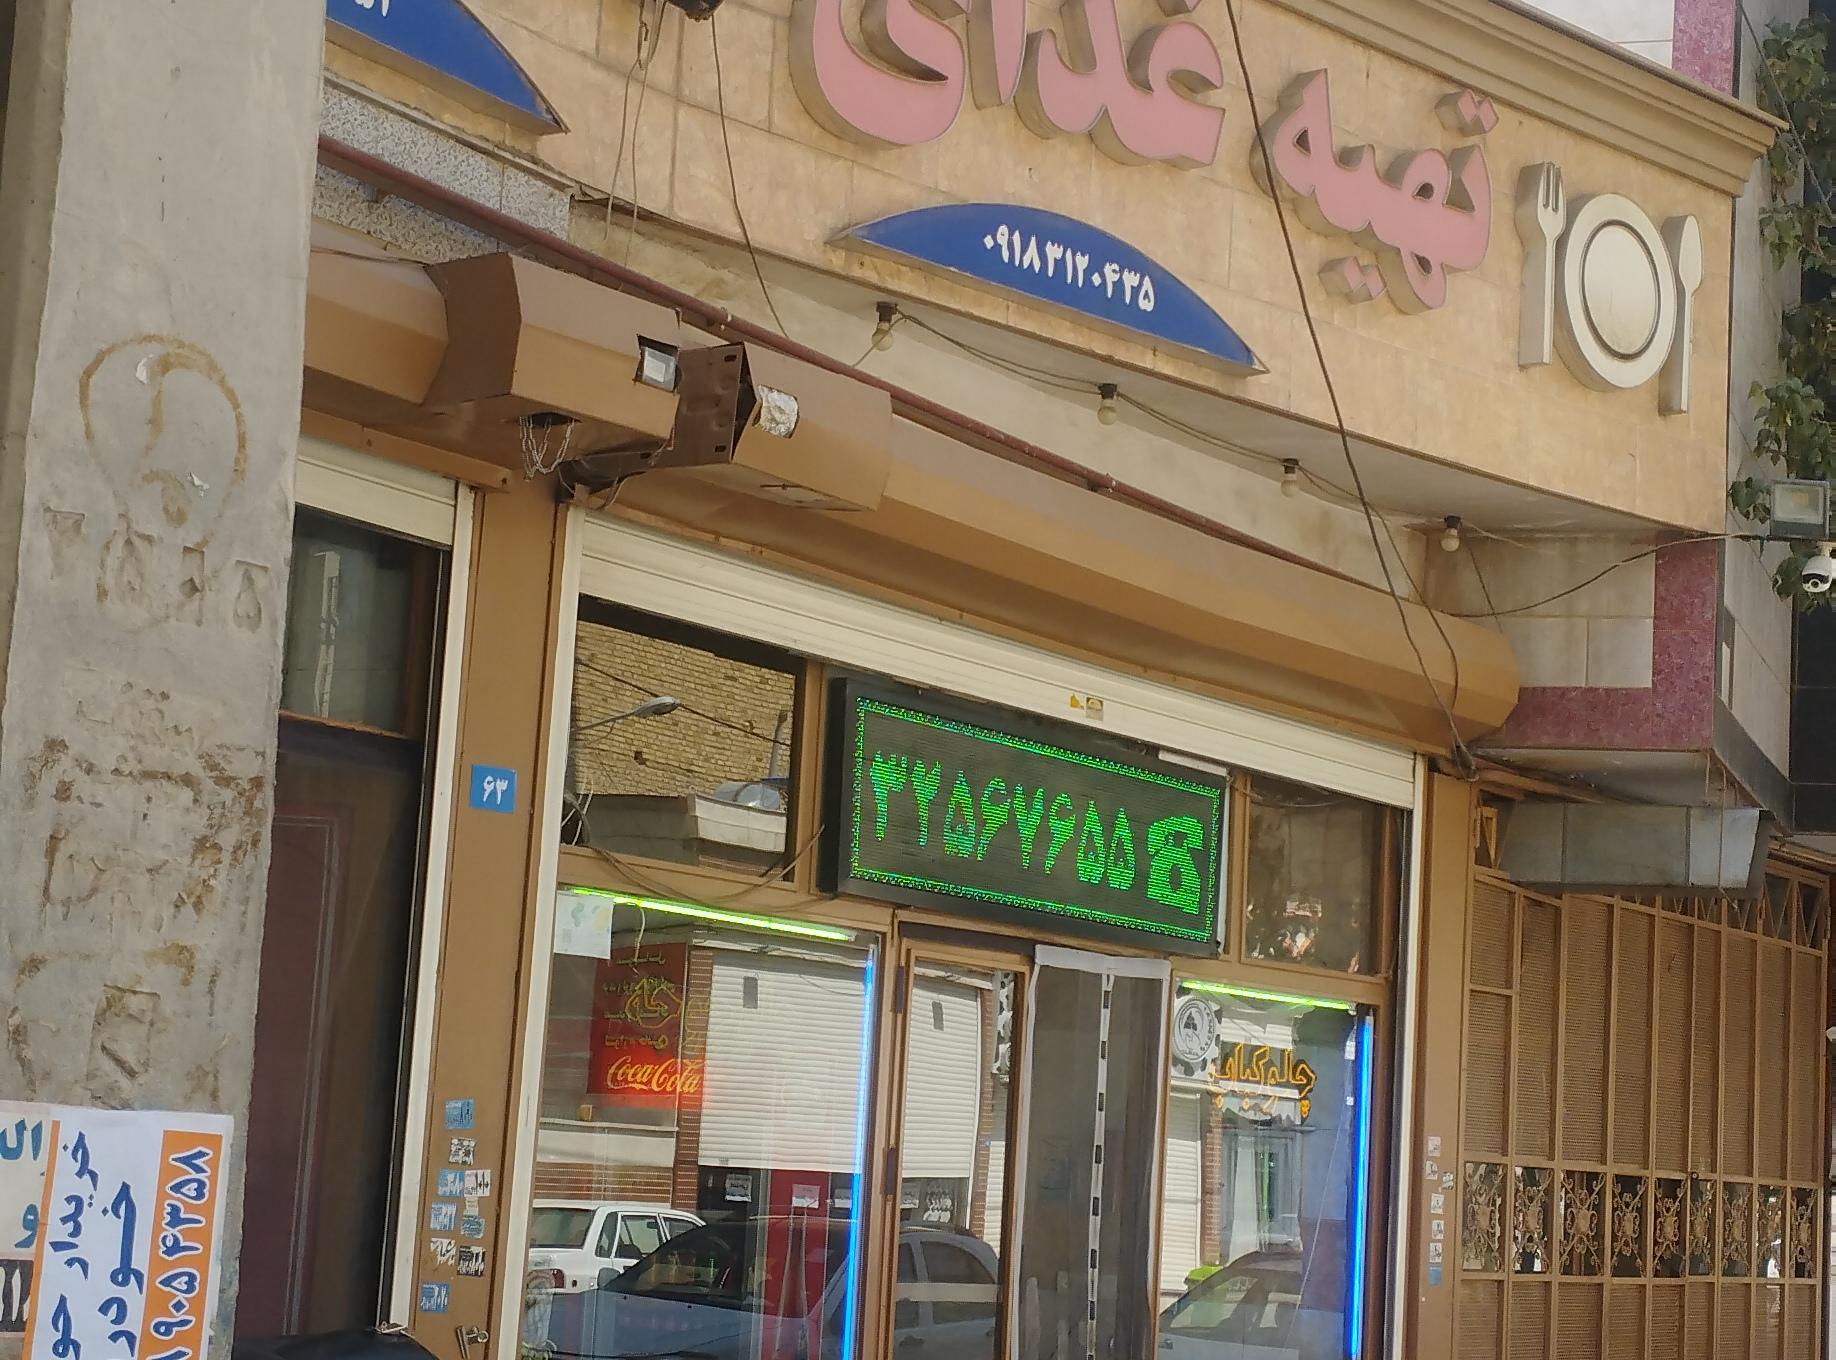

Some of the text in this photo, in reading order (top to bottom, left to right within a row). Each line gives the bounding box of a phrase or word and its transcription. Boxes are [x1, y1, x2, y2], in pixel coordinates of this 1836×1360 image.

[1263, 68, 1498, 314] تهیه
[983, 223, 1156, 313] ۰۹۱۸۳۱۲۰۴۳۵
[868, 750, 1137, 891] ۳۲۵۶۷۶۵۵
[48, 1130, 99, 1281] خریدار
[160, 1147, 213, 1258] ۴۳۵۸
[153, 1270, 199, 1338] ۹۰۵
